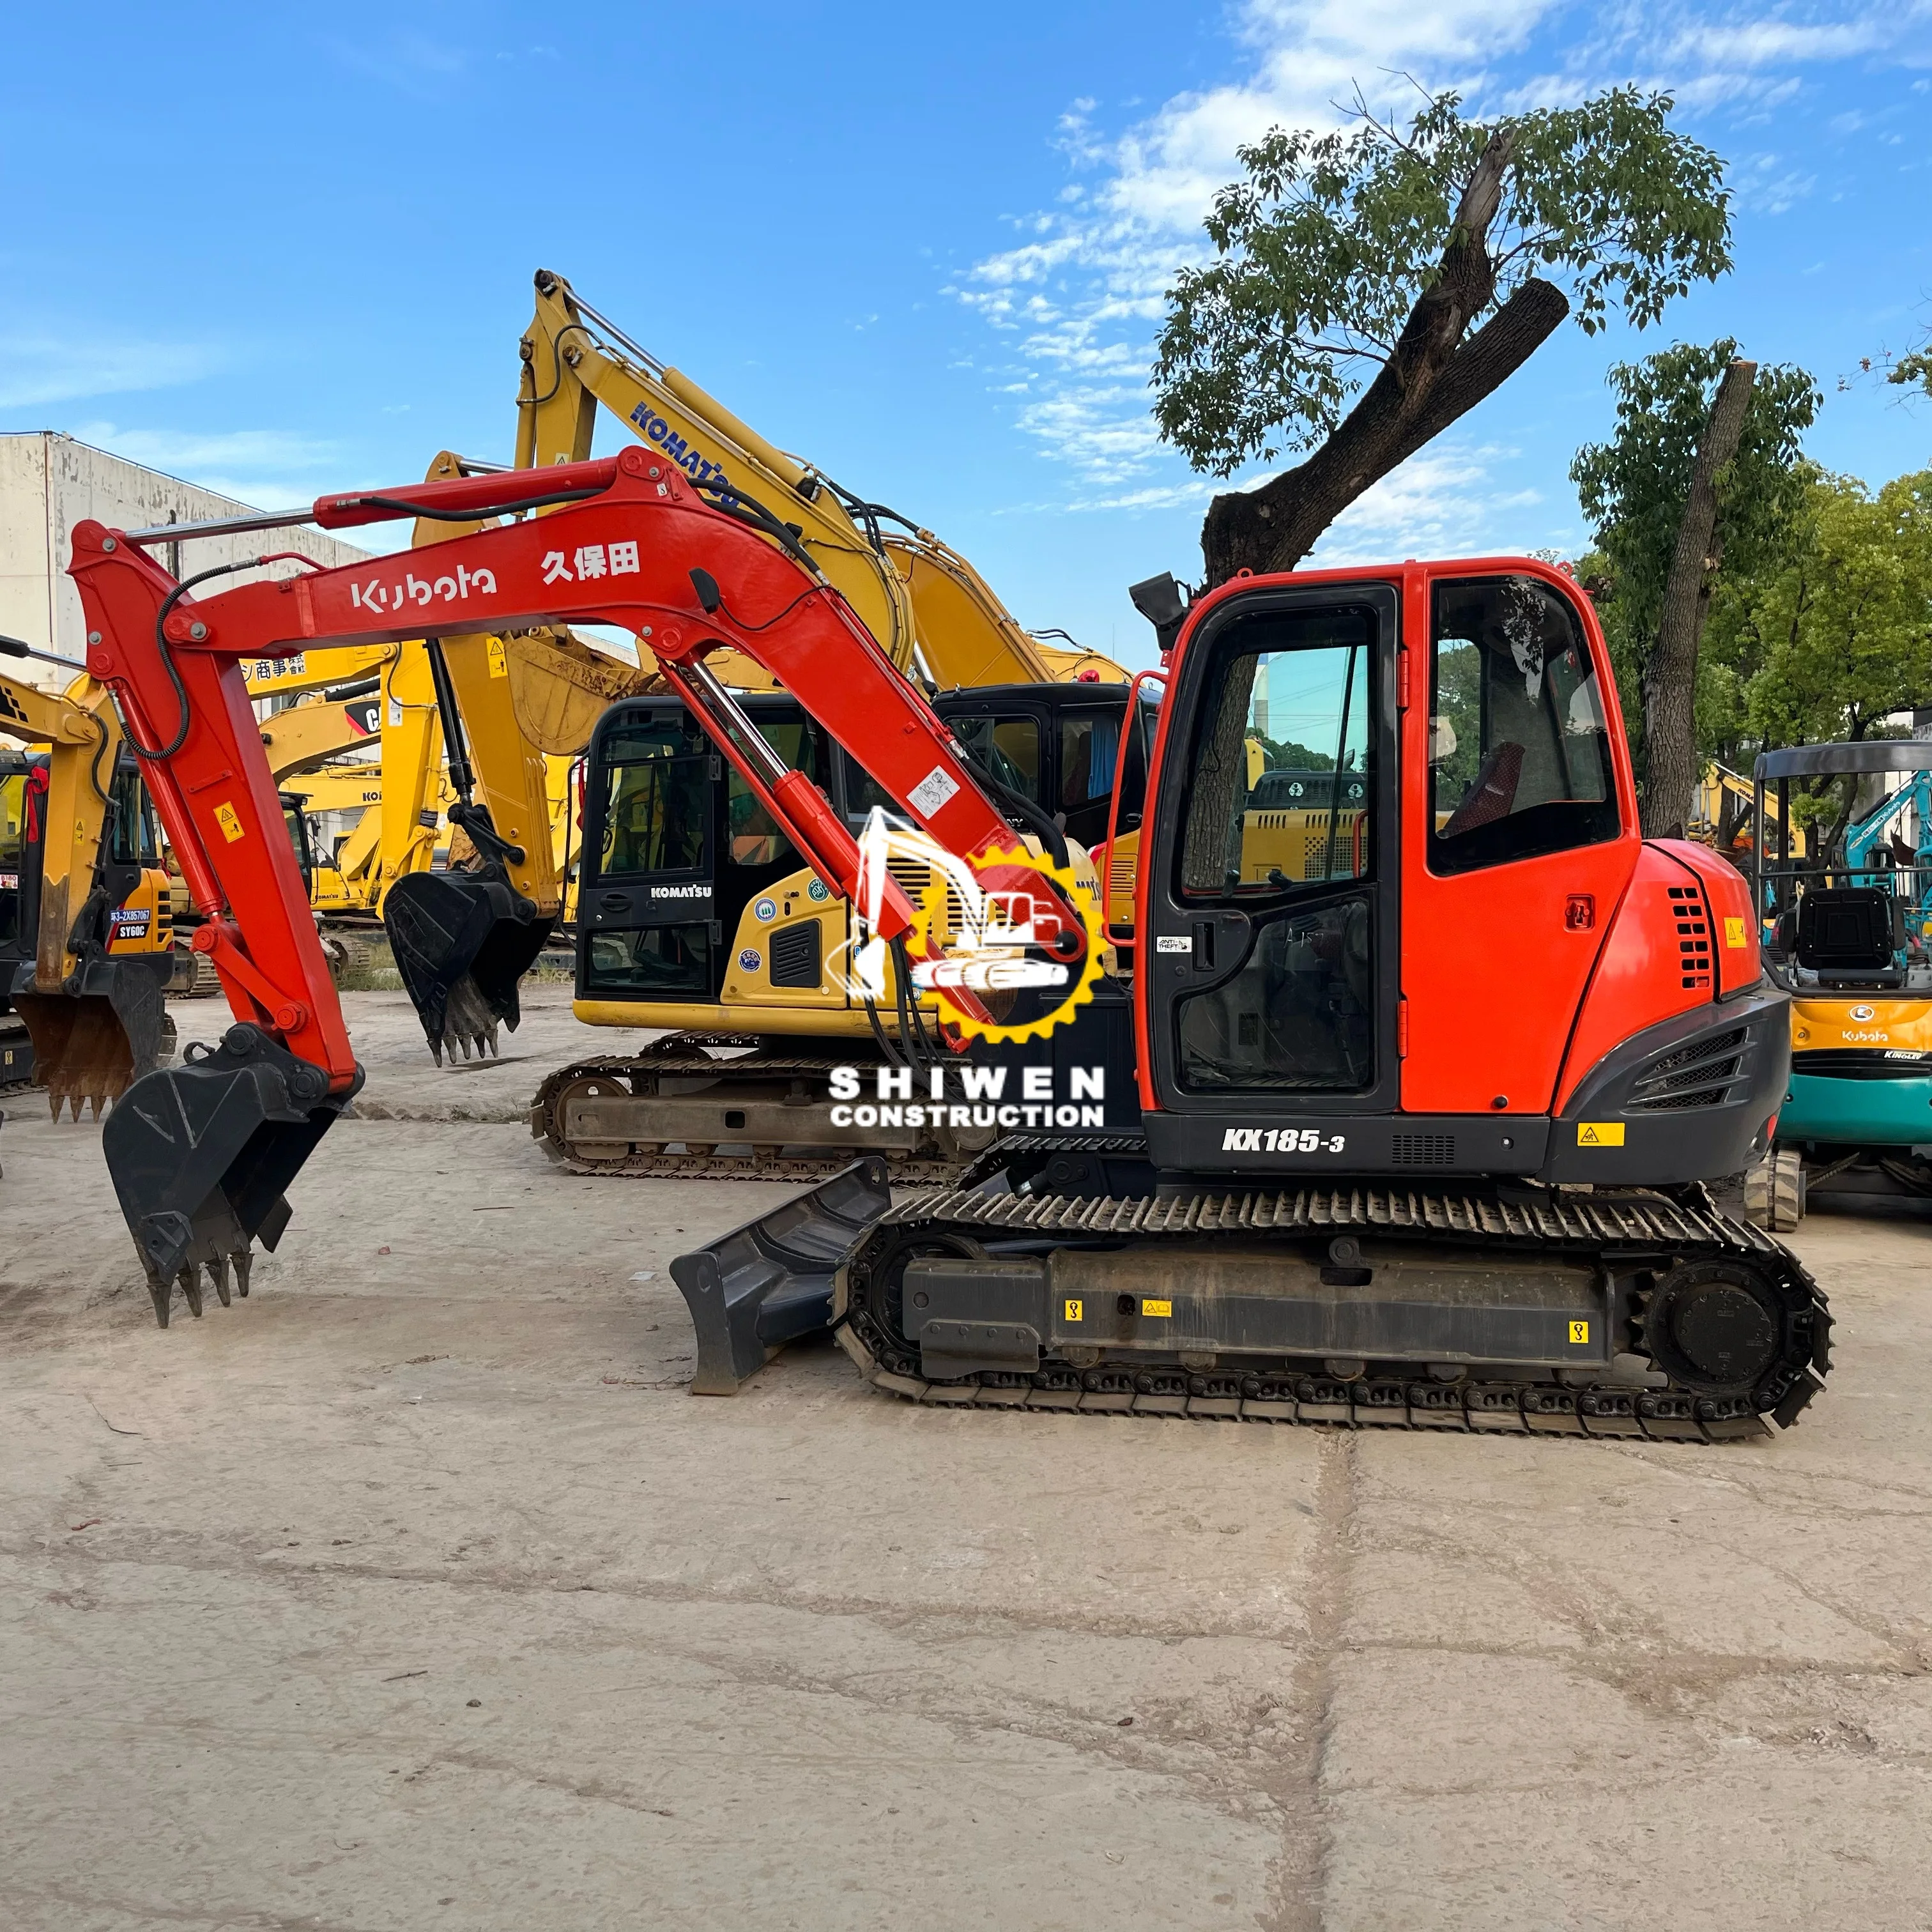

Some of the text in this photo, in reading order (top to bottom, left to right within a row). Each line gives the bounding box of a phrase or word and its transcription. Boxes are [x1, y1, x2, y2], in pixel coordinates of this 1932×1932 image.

[540, 541, 640, 585] 久保田
[351, 564, 497, 614] Kubota
[650, 884, 712, 898] KOMATSU
[120, 926, 144, 937] SY60C
[1842, 1031, 1889, 1042] Kubota
[1222, 1128, 1345, 1153] KX185-3
